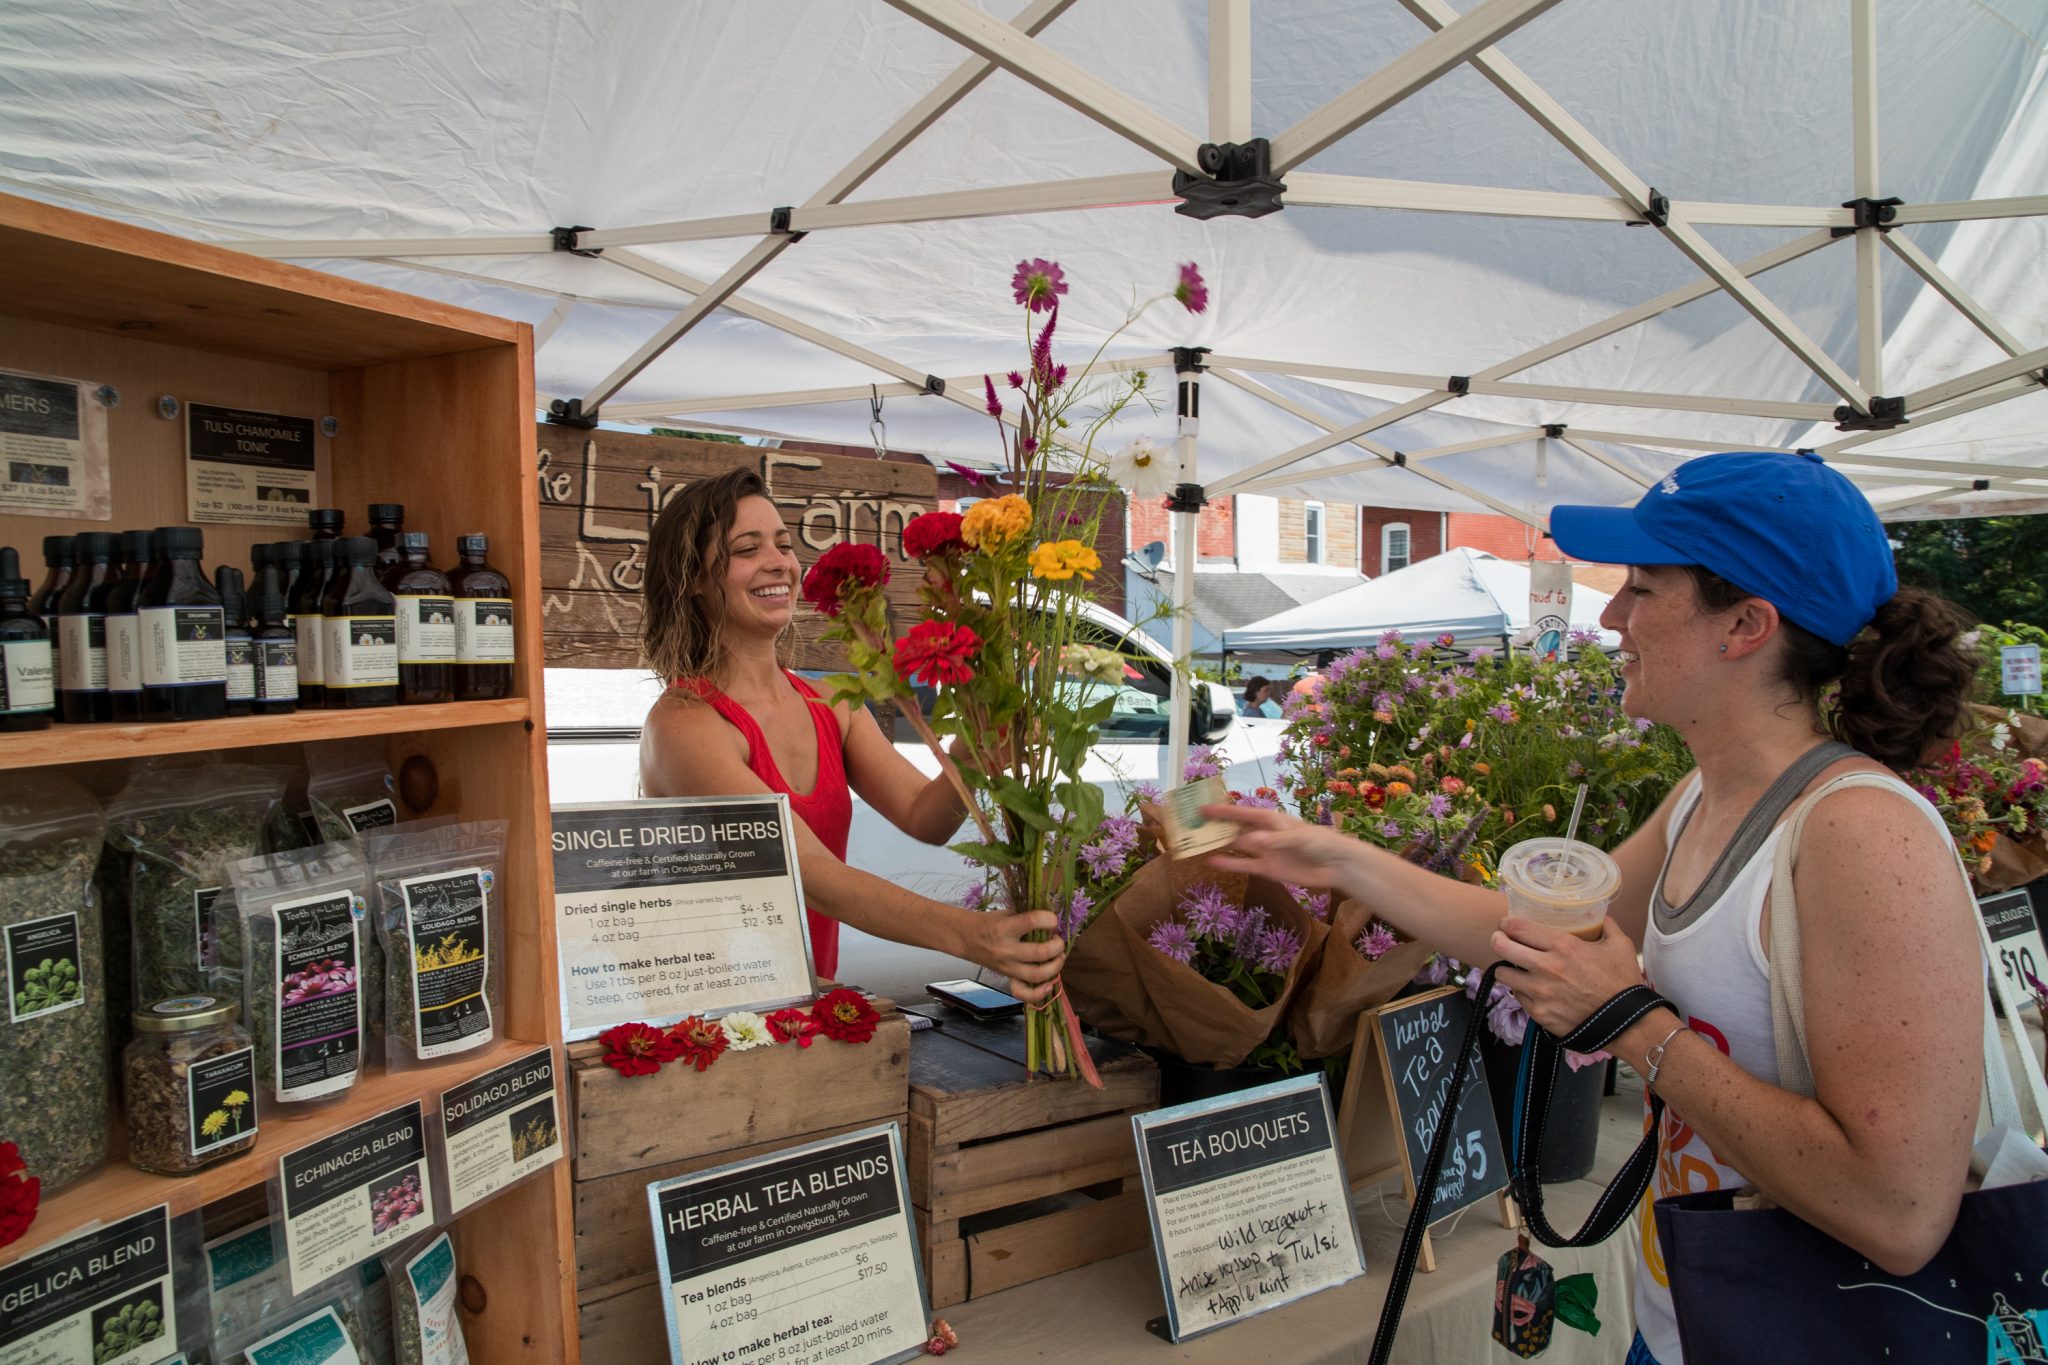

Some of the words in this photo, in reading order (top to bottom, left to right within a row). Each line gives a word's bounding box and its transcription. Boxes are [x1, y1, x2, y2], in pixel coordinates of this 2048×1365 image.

[203, 420, 233, 433] TULSI
[235, 424, 301, 442] CHAMOMILE
[237, 440, 270, 454] TONIC
[580, 440, 687, 544] Li
[761, 453, 926, 560] Farm
[1530, 590, 1553, 603] roud
[1557, 589, 1567, 604] to
[552, 829, 634, 851] SINGLE
[640, 825, 706, 846] DRIED
[712, 821, 779, 841] HERBS
[586, 857, 643, 868] Caffeine-free
[653, 854, 688, 864] Certified
[690, 851, 727, 862] Naturally
[729, 850, 755, 858] Grown
[622, 869, 637, 877] our
[639, 867, 659, 876] farm
[672, 862, 722, 873] Orwigsburg,
[725, 861, 736, 870] PA
[412, 885, 437, 895] Tooth
[452, 879, 475, 889] Lion
[284, 909, 310, 921] Tooth
[324, 903, 346, 914] Lion
[565, 904, 597, 915] Dried
[601, 902, 636, 914] single
[640, 898, 672, 909] herbs
[589, 918, 593, 928] 1
[597, 919, 610, 928] oz
[613, 917, 634, 927] bag
[740, 904, 753, 914] $4
[762, 902, 774, 911] $5
[1984, 913, 2000, 927] SMALL
[2001, 906, 2031, 923] BOUQUETS
[27, 929, 61, 941] ANGELICA
[421, 919, 456, 931] SOLIDAGO
[457, 915, 476, 924] BLEND
[592, 932, 599, 943] 4
[602, 933, 615, 942] oz
[618, 931, 639, 942] bag
[742, 918, 758, 928] $12
[288, 946, 325, 962] ECHINACEA
[327, 942, 348, 953] BLEND
[572, 965, 600, 976] How
[603, 964, 615, 972] to
[619, 959, 651, 971] make
[655, 953, 690, 966] herbal
[694, 952, 715, 962] tea:
[585, 979, 607, 990] Use
[610, 977, 614, 987] 1
[617, 975, 634, 986] tbs
[638, 974, 655, 985] per
[659, 971, 666, 980] 8
[669, 971, 681, 980] oz
[683, 963, 740, 980] just-boiled
[742, 959, 772, 969] water
[2000, 945, 2037, 991] $10
[587, 994, 623, 1007] Steep,
[626, 987, 673, 1000] covered,
[675, 983, 690, 994] for
[693, 982, 703, 991] at
[706, 978, 731, 990] least
[734, 976, 747, 985] 20
[750, 973, 777, 983] mins.
[1394, 1002, 1450, 1050] herbal
[1402, 1036, 1444, 1098] Tea
[446, 1083, 509, 1122] SOLIDAGO
[511, 1065, 551, 1092] BLEND
[1167, 1140, 1204, 1166] TEA
[1208, 1111, 1311, 1155] BOUQUETS
[295, 1145, 370, 1188] ECHINACEA
[372, 1126, 413, 1153] BLEND
[1452, 1130, 1488, 1188] $5
[668, 1192, 758, 1234] HERBAL
[762, 1179, 806, 1207] TEA
[809, 1156, 889, 1194] BLENDS
[701, 1223, 758, 1247] Caffeine-free
[759, 1221, 765, 1229] &
[766, 1208, 802, 1228] Certified
[804, 1199, 841, 1218] Naturally
[842, 1192, 869, 1207] Grown
[727, 1243, 736, 1253] at
[738, 1239, 753, 1250] our
[754, 1232, 774, 1245] farm
[776, 1229, 785, 1239] in
[786, 1213, 837, 1237] Orwigsburg,
[838, 1209, 850, 1220] PA
[1219, 1223, 1257, 1250] Wild
[0, 1266, 83, 1313] GELICA
[88, 1236, 156, 1277] BLEND
[681, 1292, 704, 1306] Tea
[707, 1276, 747, 1298] blends
[749, 1268, 781, 1286] (Angelica,
[782, 1261, 804, 1274] Avena,
[805, 1250, 838, 1266] Echinacea,
[840, 1241, 868, 1255] Ocimum,
[870, 1231, 898, 1247] Solidago)
[1179, 1271, 1217, 1298] Anise
[1218, 1252, 1261, 1281] hyssop
[1283, 1226, 1339, 1264] Tulsi
[707, 1304, 712, 1315] 1
[715, 1301, 727, 1313] oz
[730, 1292, 751, 1308] bag
[855, 1253, 869, 1266] $6
[1259, 1265, 1290, 1295] mint
[1950, 1279, 1957, 1288] 2
[2015, 1273, 2023, 1282] 2
[710, 1319, 717, 1331] 4
[720, 1317, 733, 1328] oz
[737, 1307, 758, 1323] bag
[858, 1262, 888, 1281] $17.50
[306, 1322, 330, 1336] Lion
[723, 1351, 735, 1361] to
[738, 1337, 771, 1356] make
[773, 1321, 809, 1343] herbal
[812, 1314, 833, 1329] tea:
[758, 1352, 775, 1365] per
[778, 1349, 785, 1359] 8
[788, 1344, 800, 1355] oz
[800, 1321, 858, 1353] just-boiled
[860, 1309, 889, 1328] water
[795, 1354, 810, 1365] for
[813, 1351, 823, 1362] at
[825, 1340, 850, 1356] least
[852, 1335, 865, 1347] 20
[867, 1324, 894, 1341] mins.
